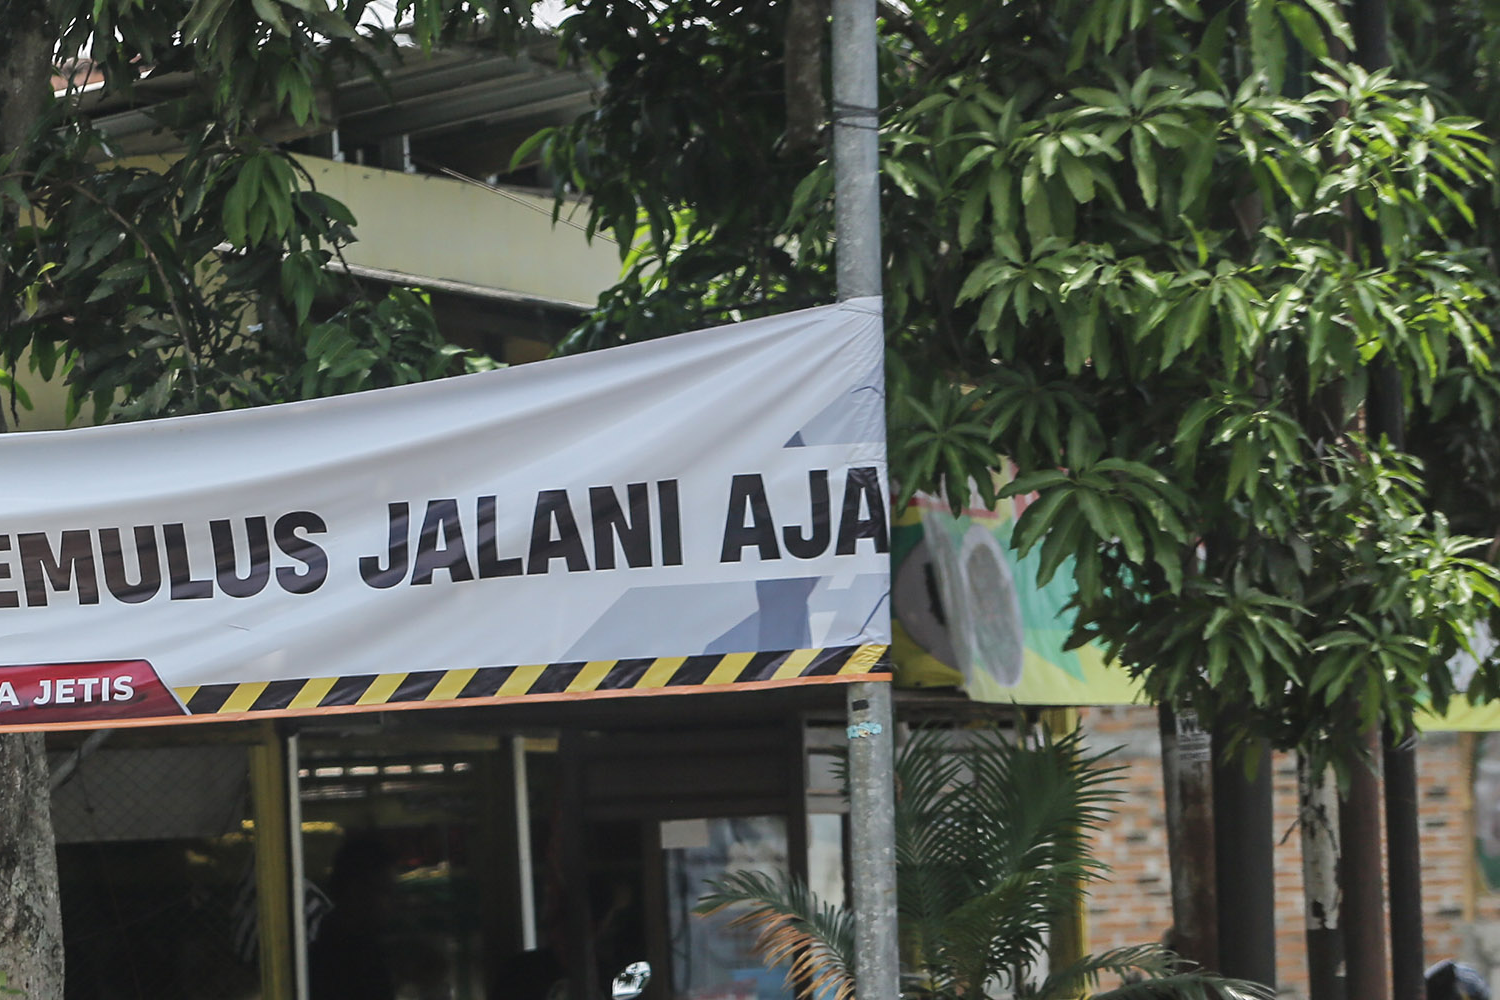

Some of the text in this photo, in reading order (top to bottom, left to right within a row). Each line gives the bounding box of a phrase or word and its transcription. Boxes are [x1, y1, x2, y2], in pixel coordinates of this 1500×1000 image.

[358, 478, 683, 590] JALANI
[720, 466, 890, 563] AJA
[34, 675, 135, 706] JETIS
